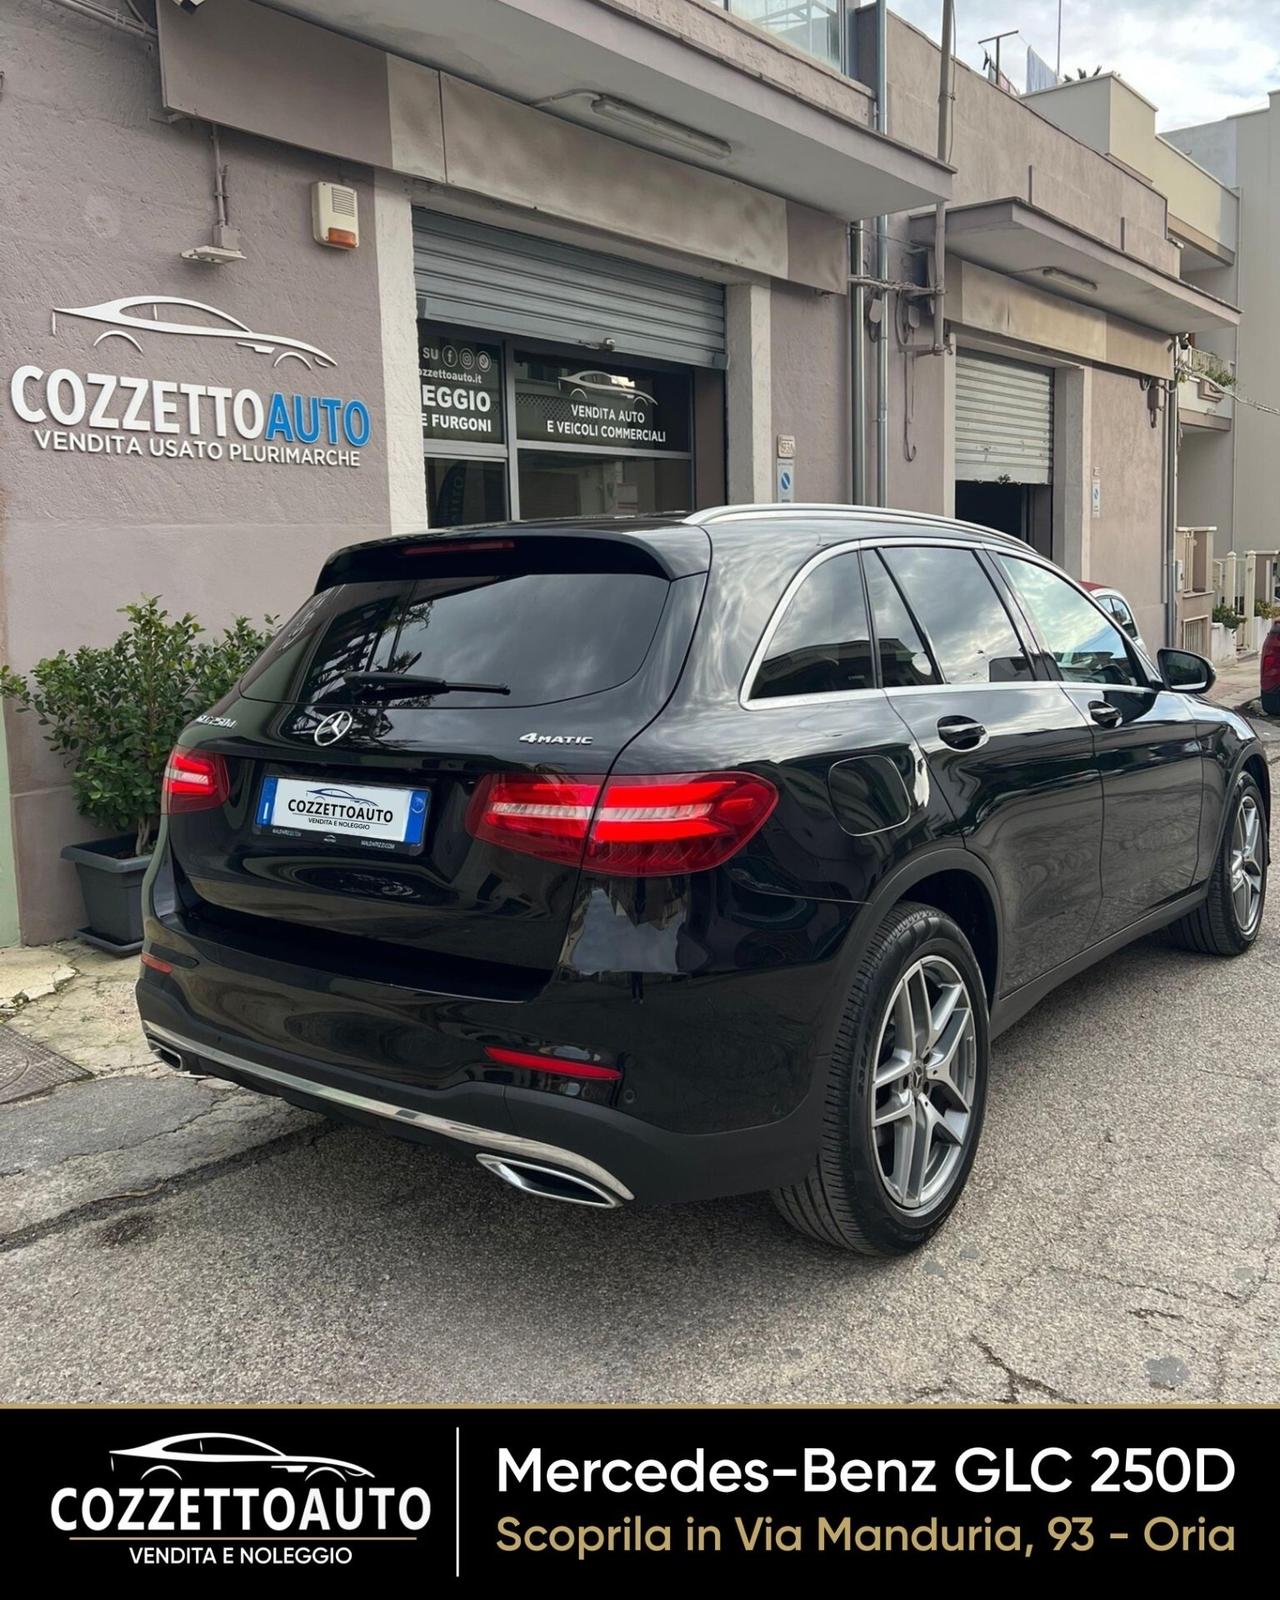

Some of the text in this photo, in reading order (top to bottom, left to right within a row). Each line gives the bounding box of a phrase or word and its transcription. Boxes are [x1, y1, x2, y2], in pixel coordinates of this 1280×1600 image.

[422, 347, 439, 360] SU
[10, 364, 373, 447] COZZETTOAUTO
[570, 404, 645, 424] VENDITA AUTO
[431, 413, 492, 432] FURGONI
[547, 420, 666, 443] E VEICOLI COMMERCIALI
[33, 429, 361, 467] VENDITA USATO PLURIMARCHE
[519, 732, 593, 745] 4MATIC
[288, 799, 393, 823] COZZETTOAUTO
[308, 817, 333, 826] VENDITA
[338, 820, 370, 830] NOLEGGIO
